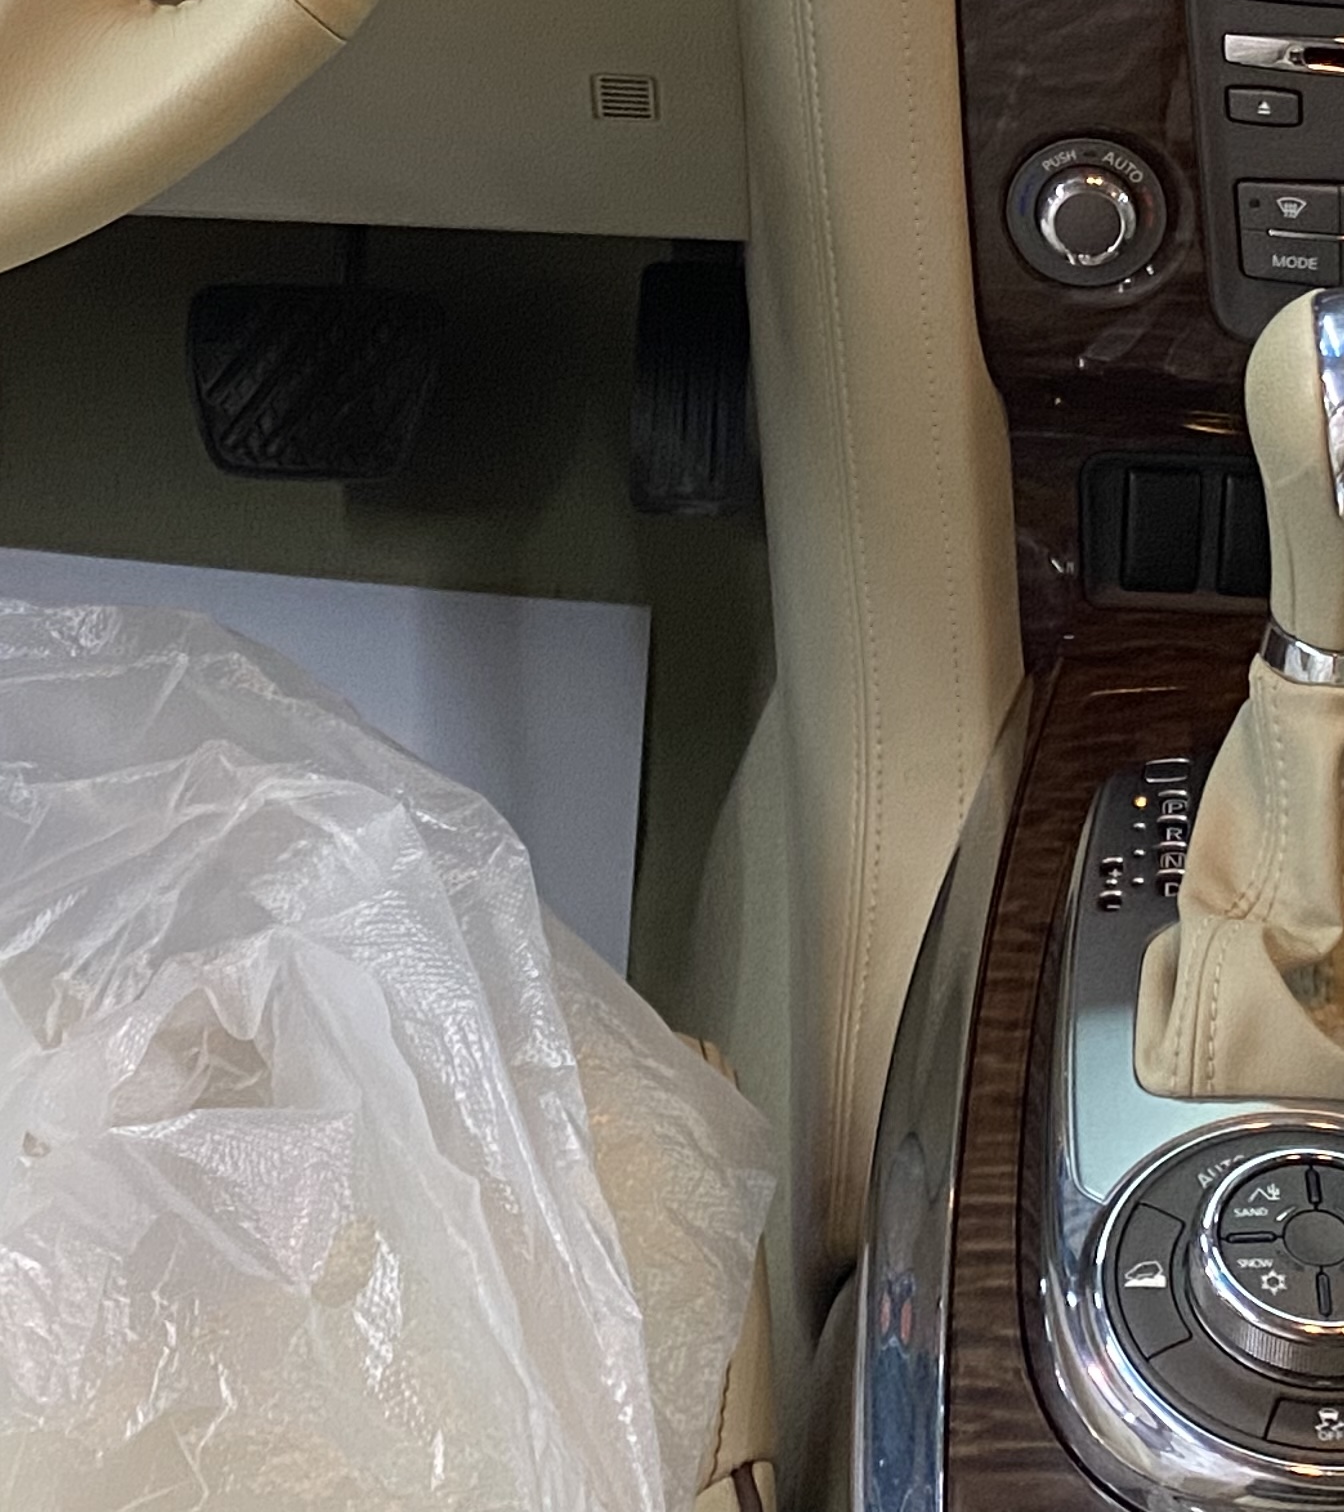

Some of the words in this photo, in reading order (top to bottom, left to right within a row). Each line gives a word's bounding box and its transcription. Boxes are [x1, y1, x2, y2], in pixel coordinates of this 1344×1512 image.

[1042, 150, 1077, 171] PUSH
[1101, 152, 1143, 183] AUTO
[1272, 254, 1319, 270] MODE
[1168, 802, 1183, 815] P
[1166, 827, 1183, 841] R
[1165, 854, 1182, 868] N
[1234, 1207, 1269, 1218] SAND
[1237, 1258, 1274, 1269] SNOW
